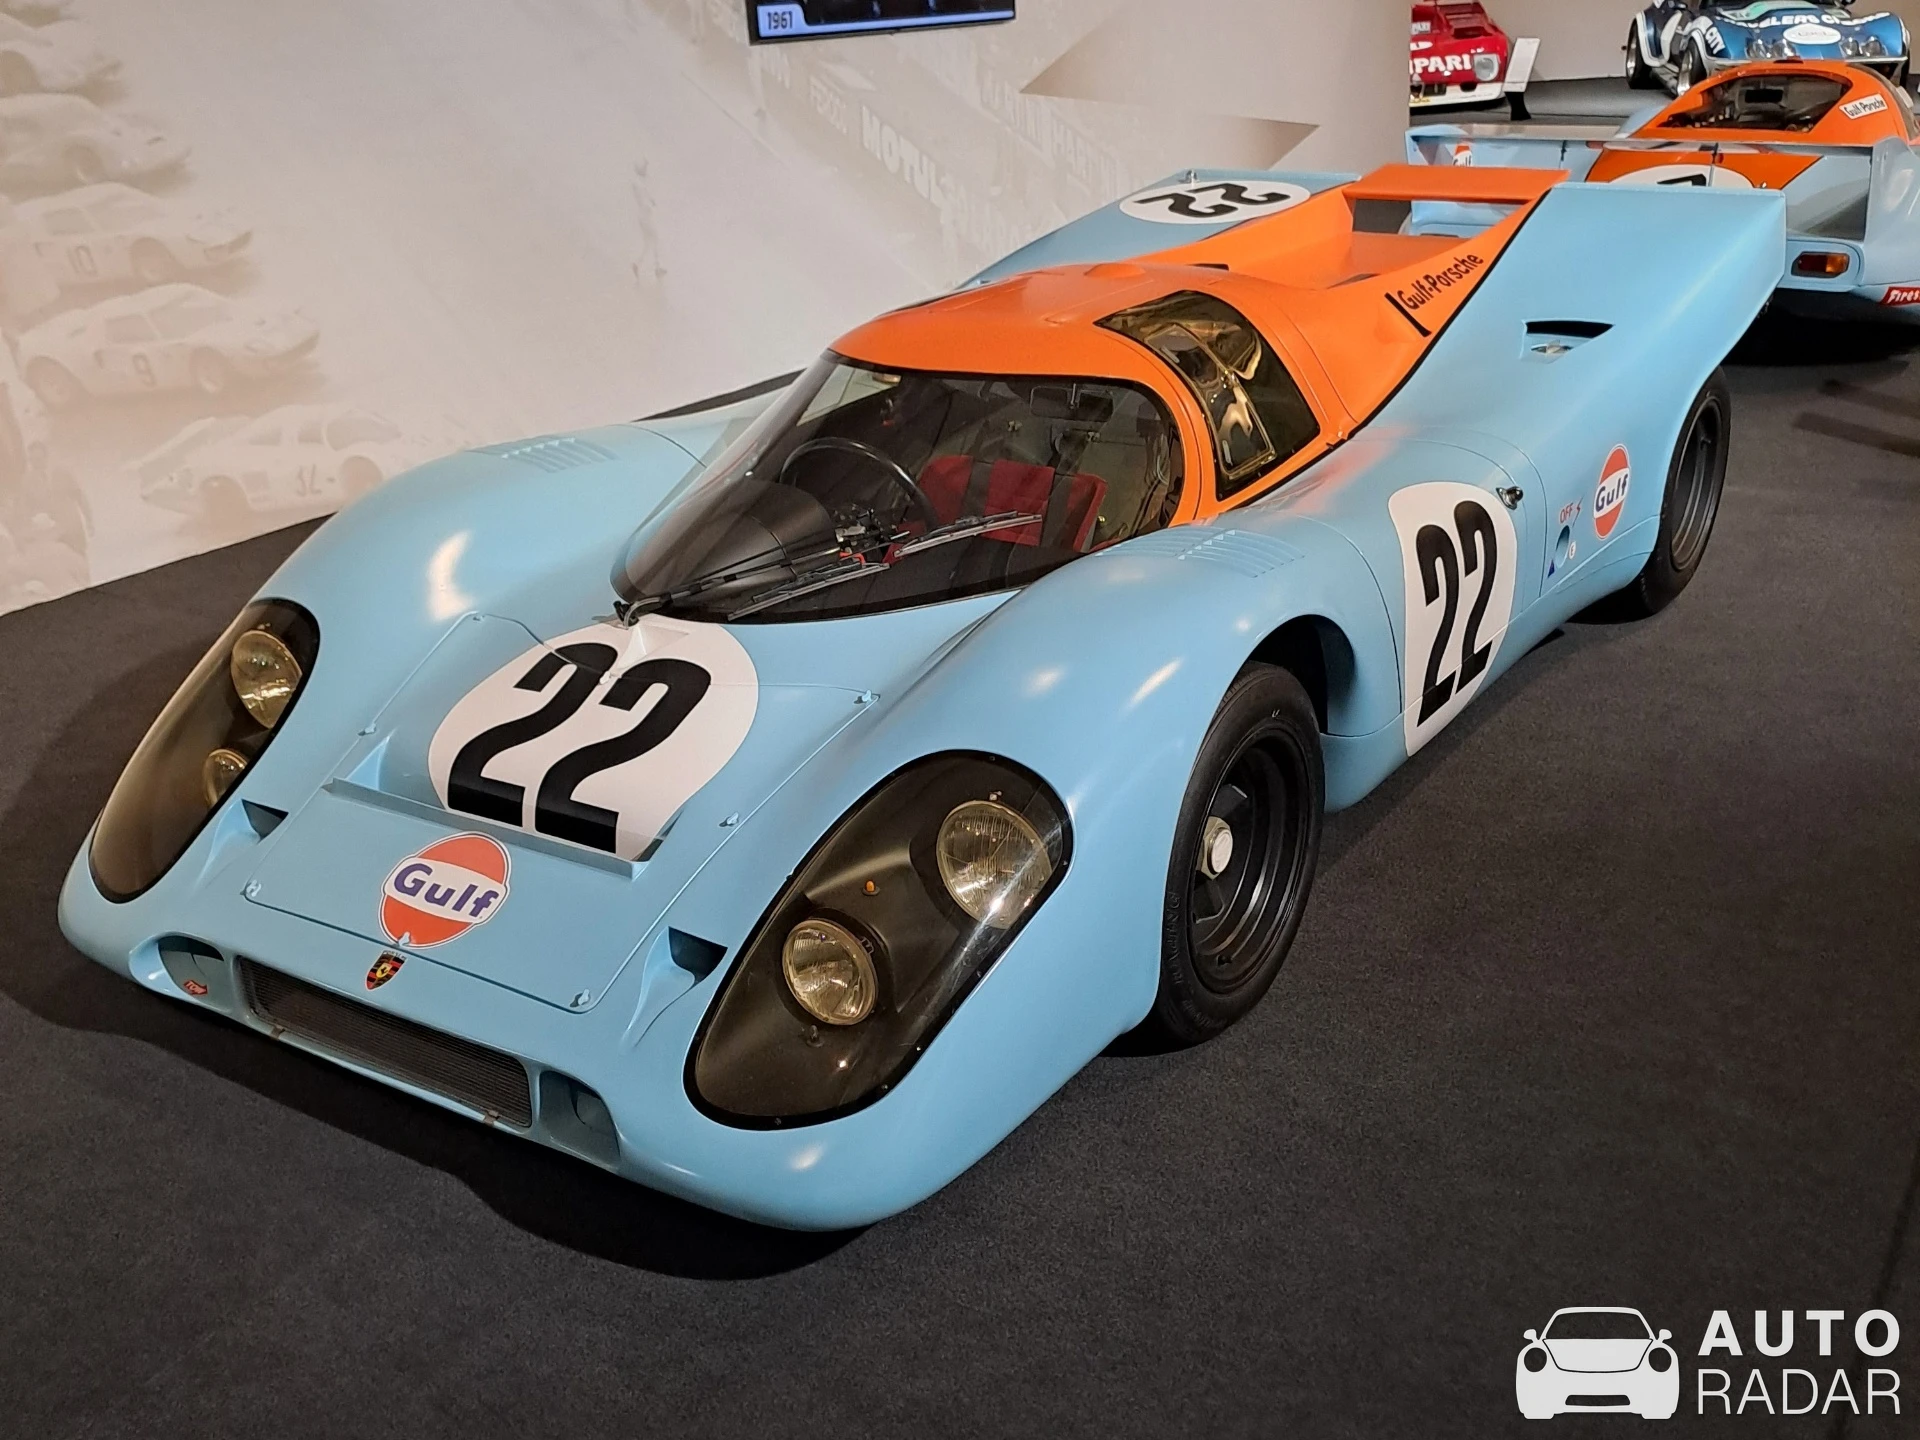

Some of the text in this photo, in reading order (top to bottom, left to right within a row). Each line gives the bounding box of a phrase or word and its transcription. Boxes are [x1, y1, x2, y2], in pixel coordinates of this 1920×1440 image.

[767, 11, 793, 30] 1961
[1409, 53, 1472, 74] PARI
[862, 104, 944, 210] MOTUL
[1133, 183, 1291, 218] 22
[1887, 289, 1920, 304] Fires
[1595, 473, 1629, 512] Gulf
[1560, 502, 1574, 523] OFF
[1416, 500, 1498, 728] 22
[447, 642, 712, 854] 22
[394, 863, 500, 918] Gulf
